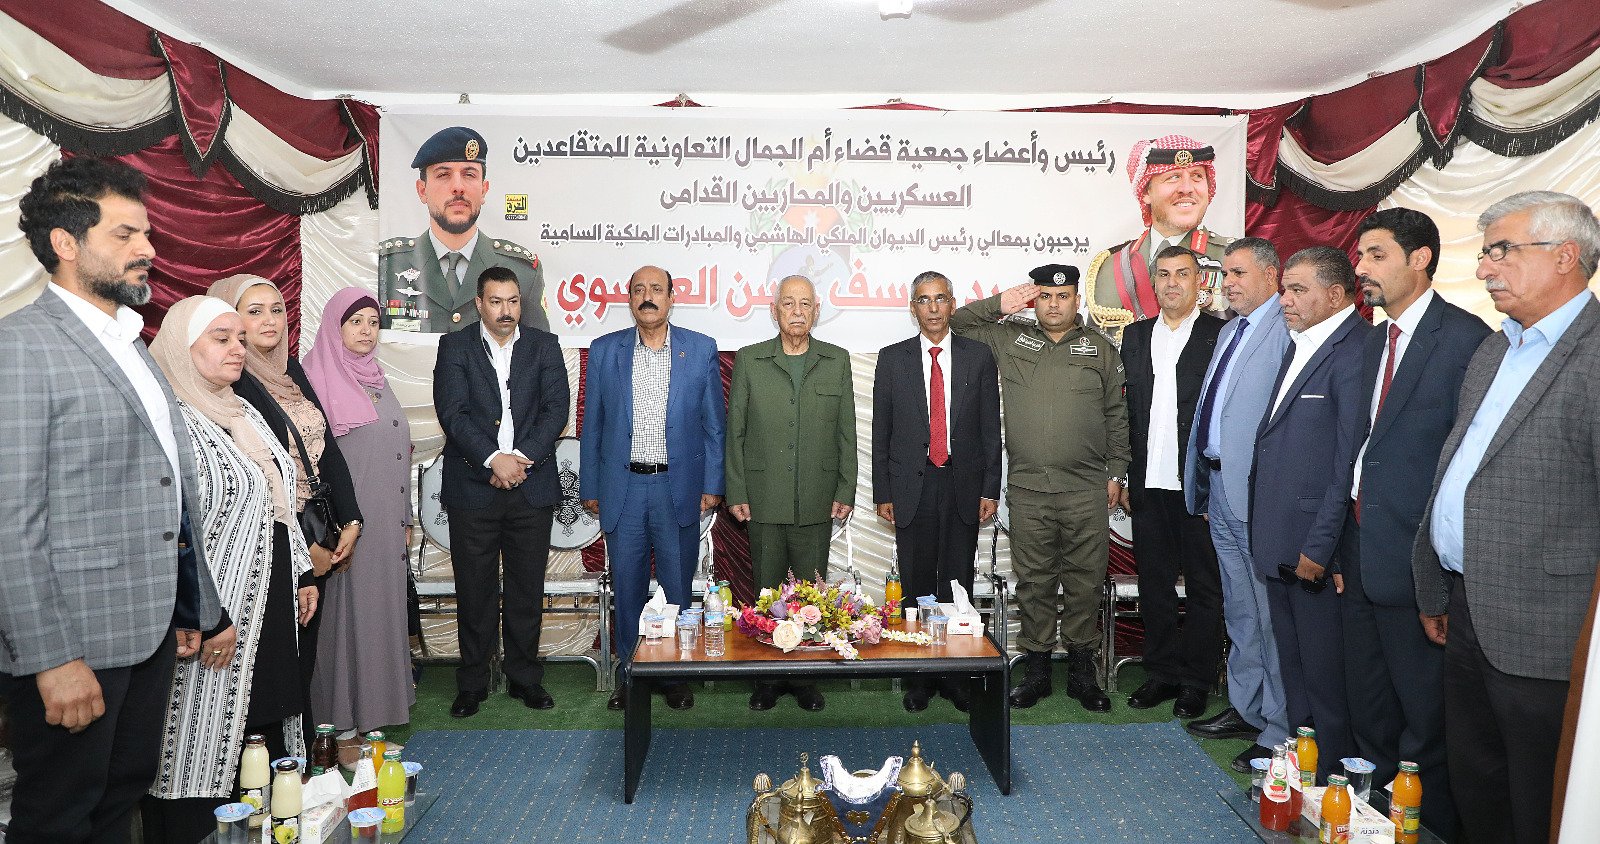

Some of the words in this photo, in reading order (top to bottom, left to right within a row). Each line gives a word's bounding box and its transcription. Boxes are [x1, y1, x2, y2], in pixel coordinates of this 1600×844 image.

[513, 129, 630, 165] للمتقاعدين
[634, 135, 731, 168] التعاونية
[735, 137, 804, 168] الجمال
[807, 128, 832, 171] أم
[835, 134, 892, 163] قضاء
[897, 139, 968, 170] جمعية
[973, 130, 1049, 173] وأعضاء
[1055, 140, 1116, 174] رئيس
[660, 176, 738, 210] القدامى
[741, 181, 853, 215] والمحاربين
[857, 183, 972, 215] العسكريين
[540, 223, 602, 246] السامية
[604, 223, 660, 247] الملكية
[662, 224, 742, 249] والمبادرات
[744, 223, 814, 253] الهاشمي
[816, 226, 867, 254] الملكي
[869, 228, 925, 250] الديوان
[928, 227, 974, 252] رئيس
[977, 229, 1031, 257] بمعالي
[1033, 233, 1090, 254] يرحبون
